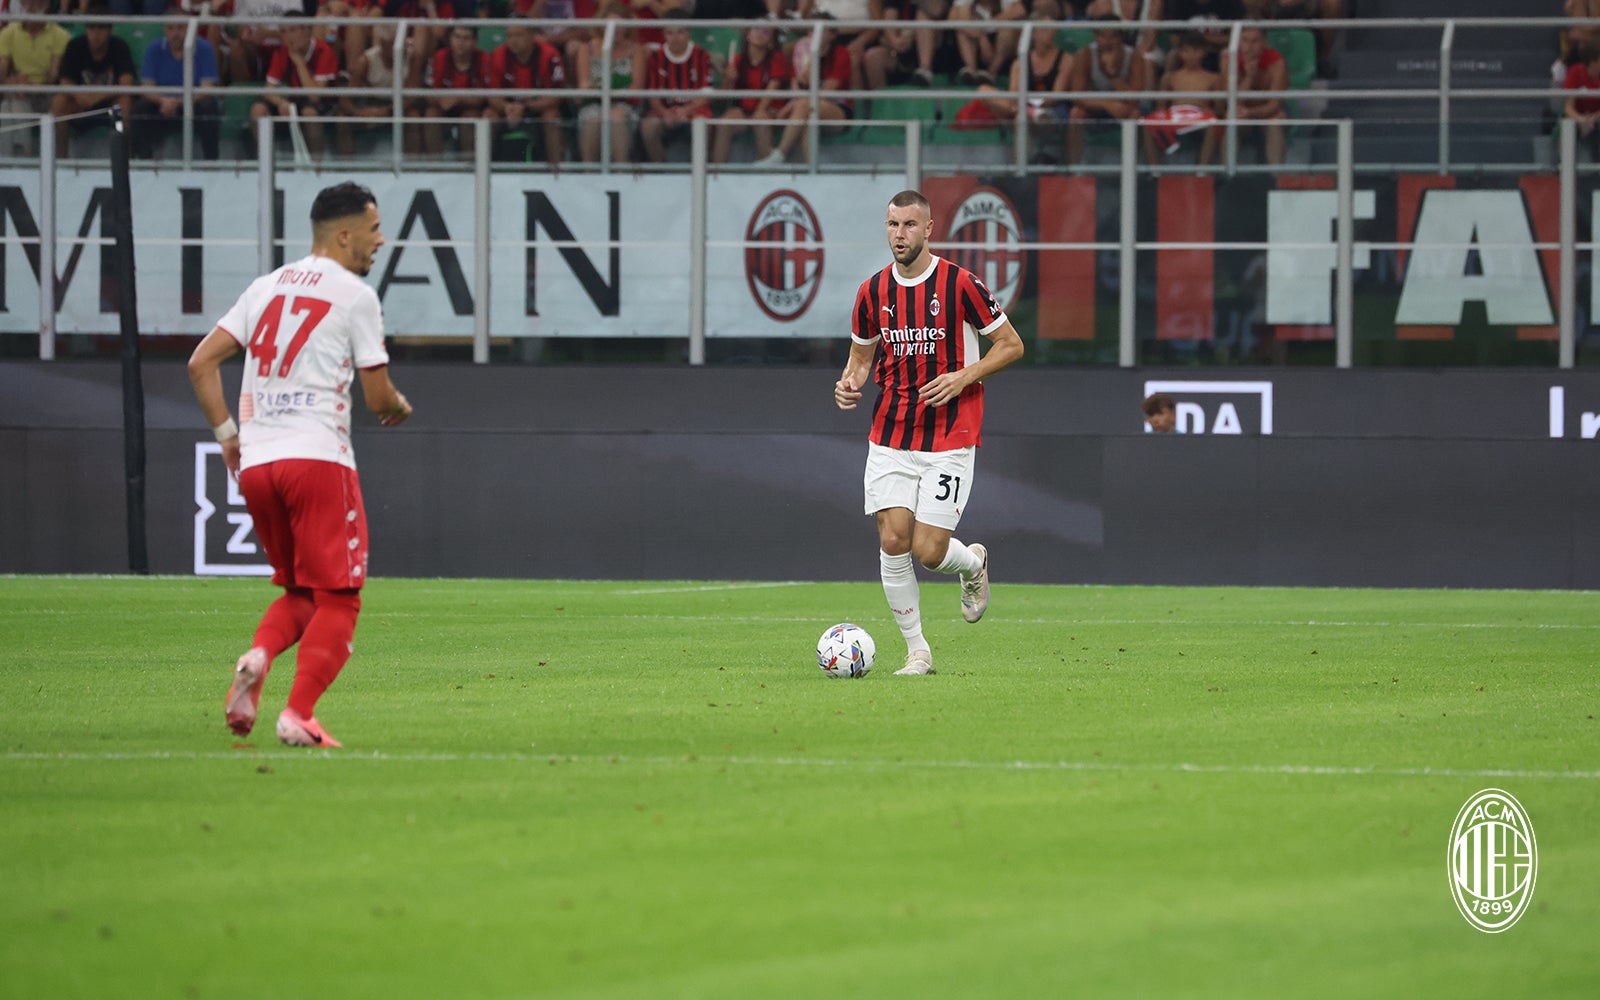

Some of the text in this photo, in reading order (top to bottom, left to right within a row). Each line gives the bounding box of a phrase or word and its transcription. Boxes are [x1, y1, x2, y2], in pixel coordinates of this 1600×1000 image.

[1266, 189, 1600, 325] FA
[249, 295, 332, 378] 47
[881, 325, 946, 342] Emirates
[935, 473, 961, 503] 31
